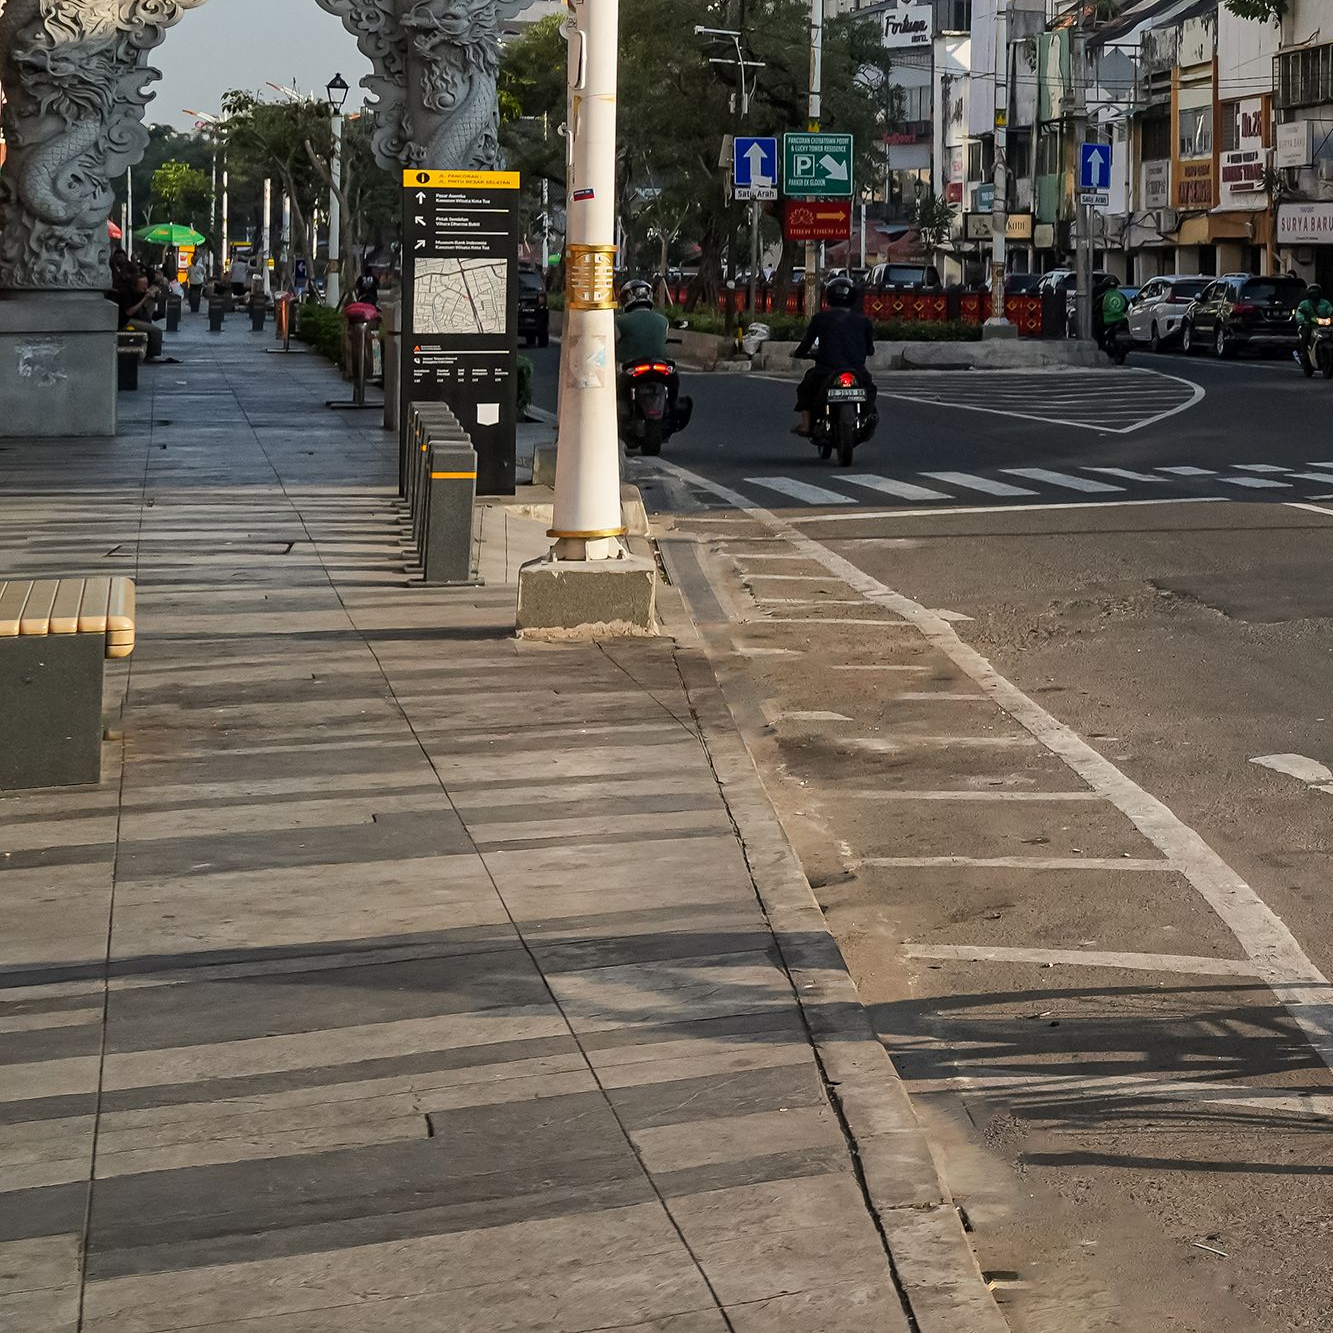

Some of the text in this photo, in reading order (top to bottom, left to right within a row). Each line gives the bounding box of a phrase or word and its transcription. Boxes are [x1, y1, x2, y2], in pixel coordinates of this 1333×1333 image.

[757, 189, 774, 197] Arah
[1281, 216, 1333, 232] SURYA BARU
